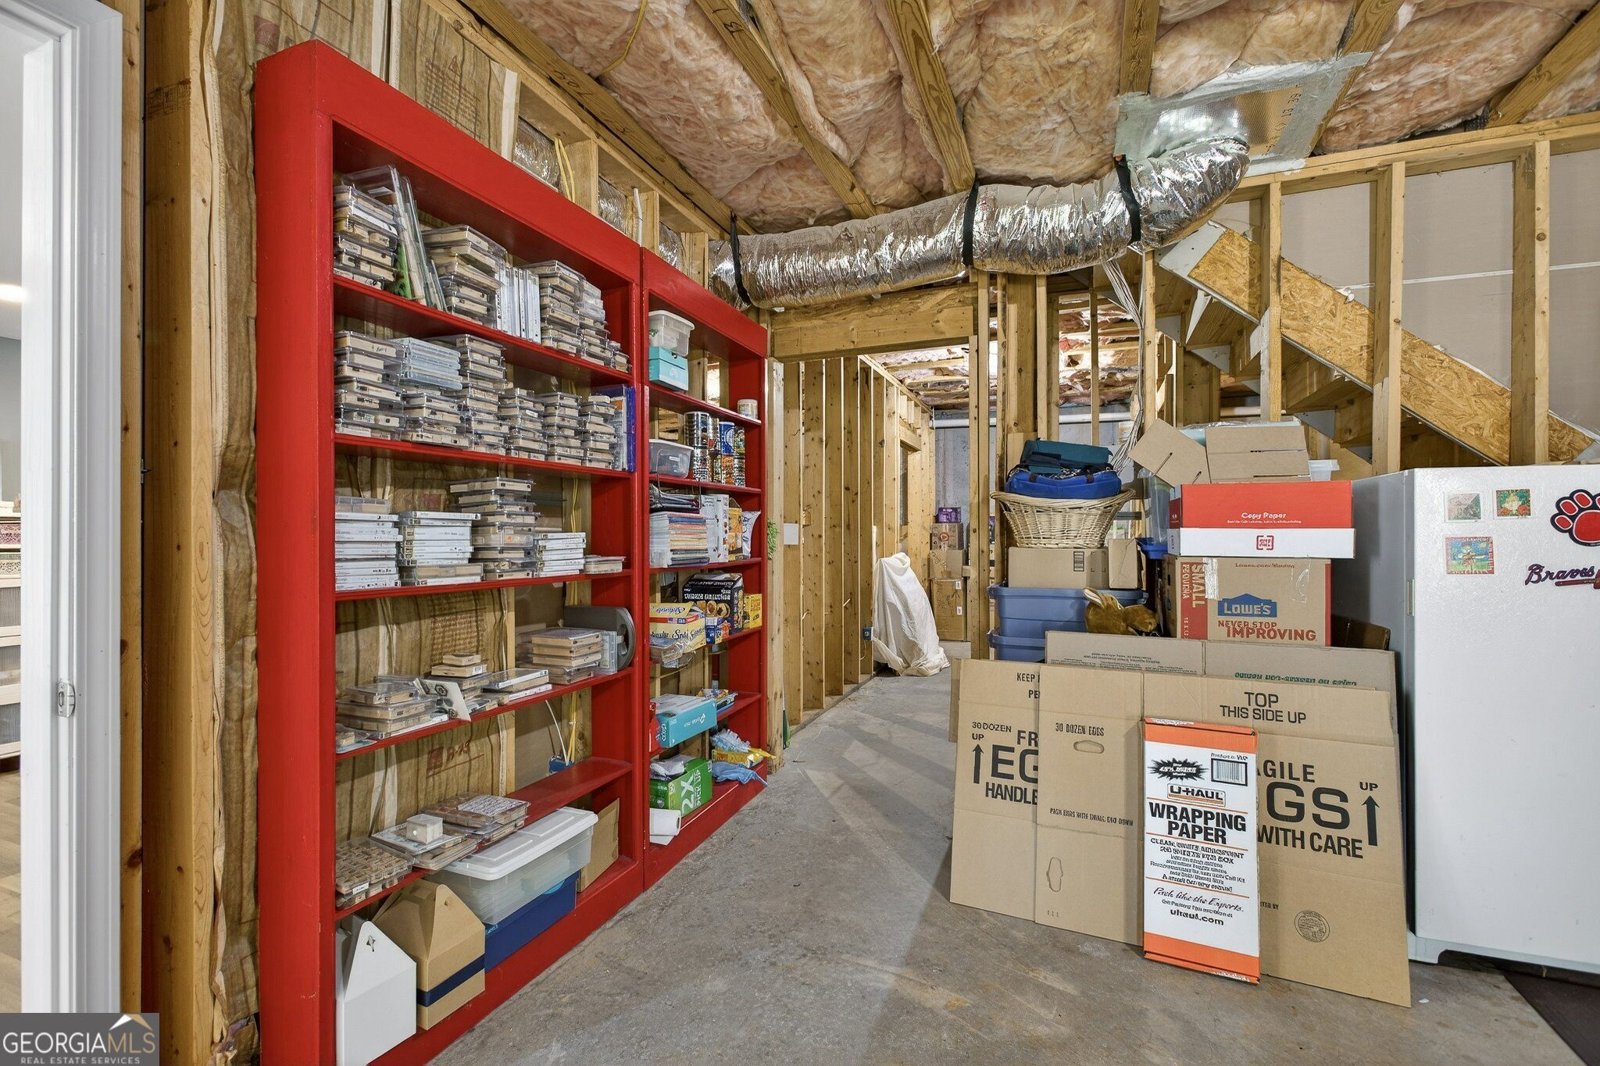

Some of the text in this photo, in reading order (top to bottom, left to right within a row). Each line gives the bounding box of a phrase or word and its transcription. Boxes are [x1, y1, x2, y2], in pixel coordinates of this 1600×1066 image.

[1241, 511, 1287, 520] Copy Paper
[1524, 563, 1595, 586] Braves
[1191, 563, 1206, 608] SMALL
[1217, 619, 1278, 630] NEVER STOP
[1226, 626, 1317, 641] IMPROVING
[1016, 672, 1036, 682] KEEP
[1244, 691, 1279, 708] TOP
[1220, 704, 1307, 724] THIS SIDE UP
[971, 721, 1012, 733] 30 DOZEN
[1055, 722, 1064, 732] 30
[971, 732, 985, 741] UP
[1169, 785, 1224, 801] U-HAUL
[1359, 781, 1379, 791] UP
[1148, 801, 1247, 832] WRAPPING
[1167, 820, 1227, 845] PAPER
[1257, 824, 1364, 859] WITH CARE
[1153, 886, 1174, 898] Pack
